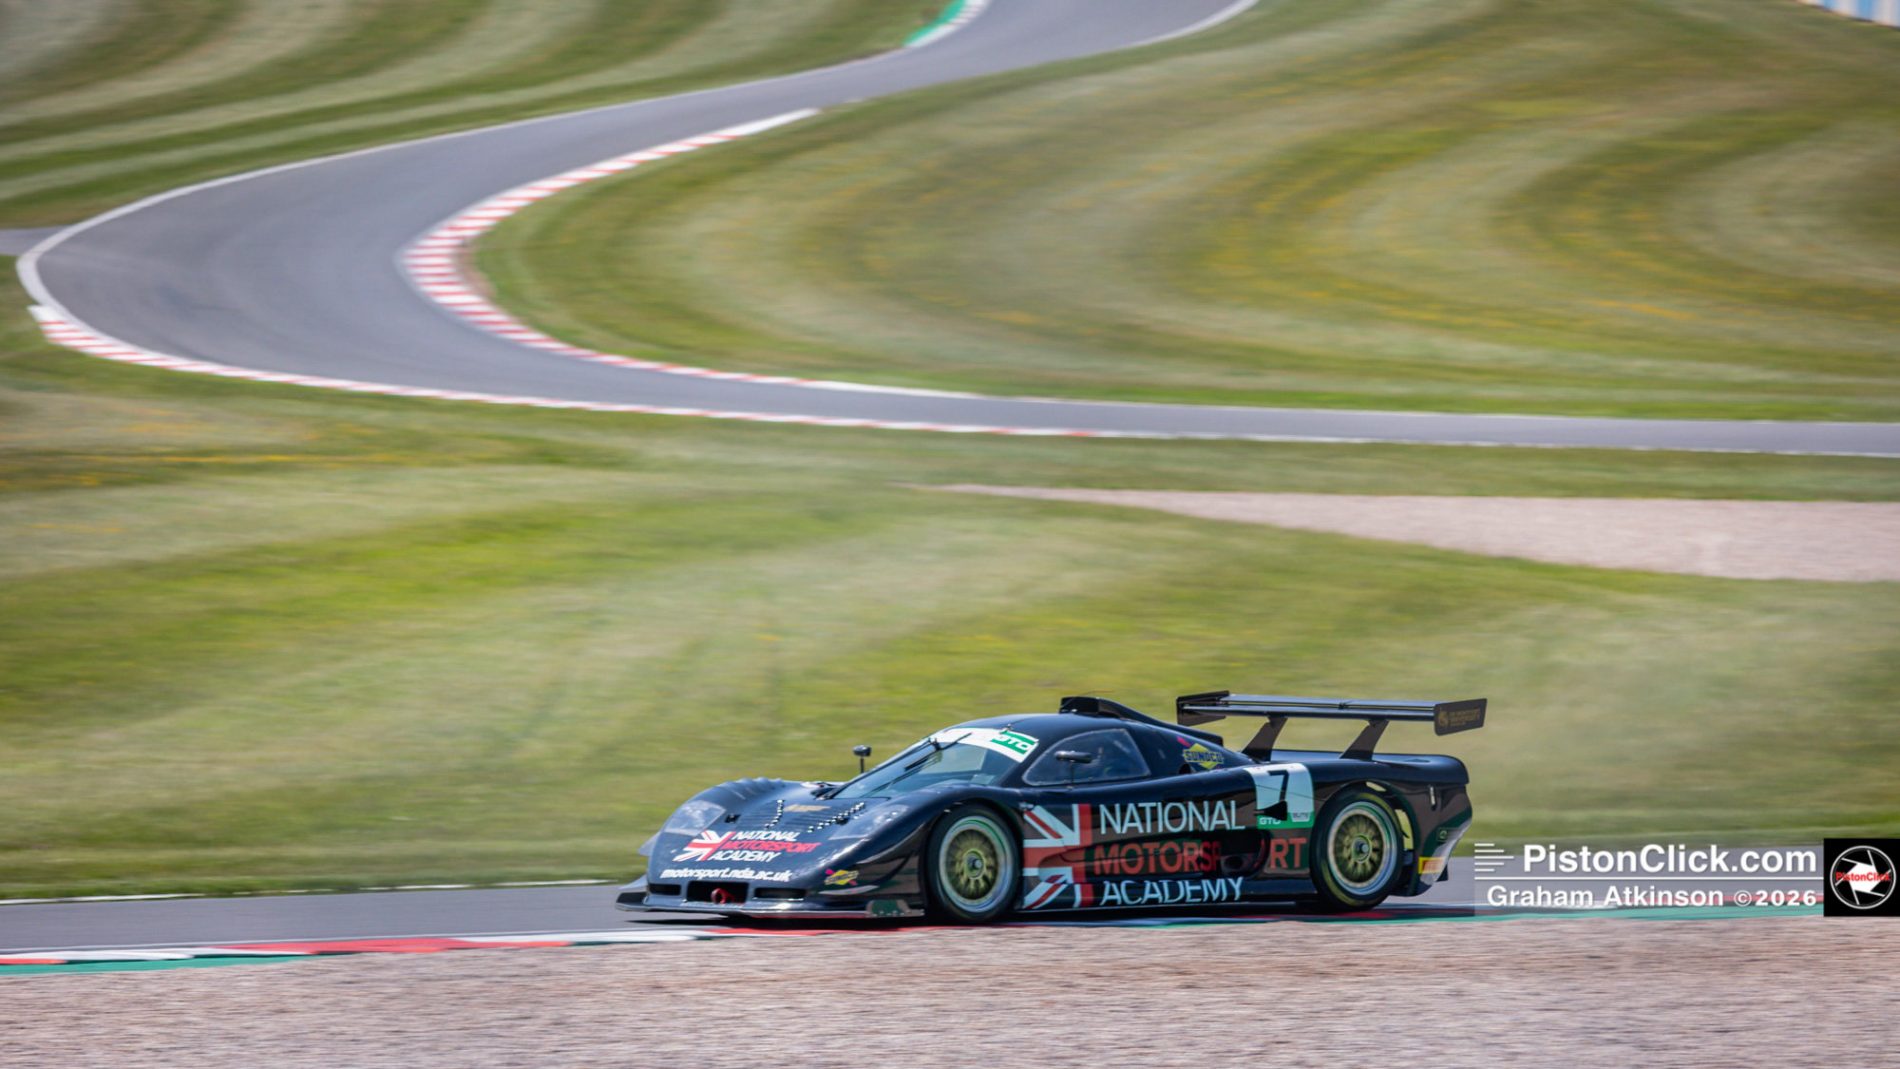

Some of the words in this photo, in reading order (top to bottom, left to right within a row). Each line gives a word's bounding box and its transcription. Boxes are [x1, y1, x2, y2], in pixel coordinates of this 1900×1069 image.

[1266, 769, 1289, 802] 7
[1100, 800, 1245, 834] NATIONAL
[733, 830, 801, 842] NATIONAL
[710, 851, 782, 862] ACADEMY
[720, 841, 822, 853] MOTORSPORT
[1101, 876, 1244, 906] ACADEMY
